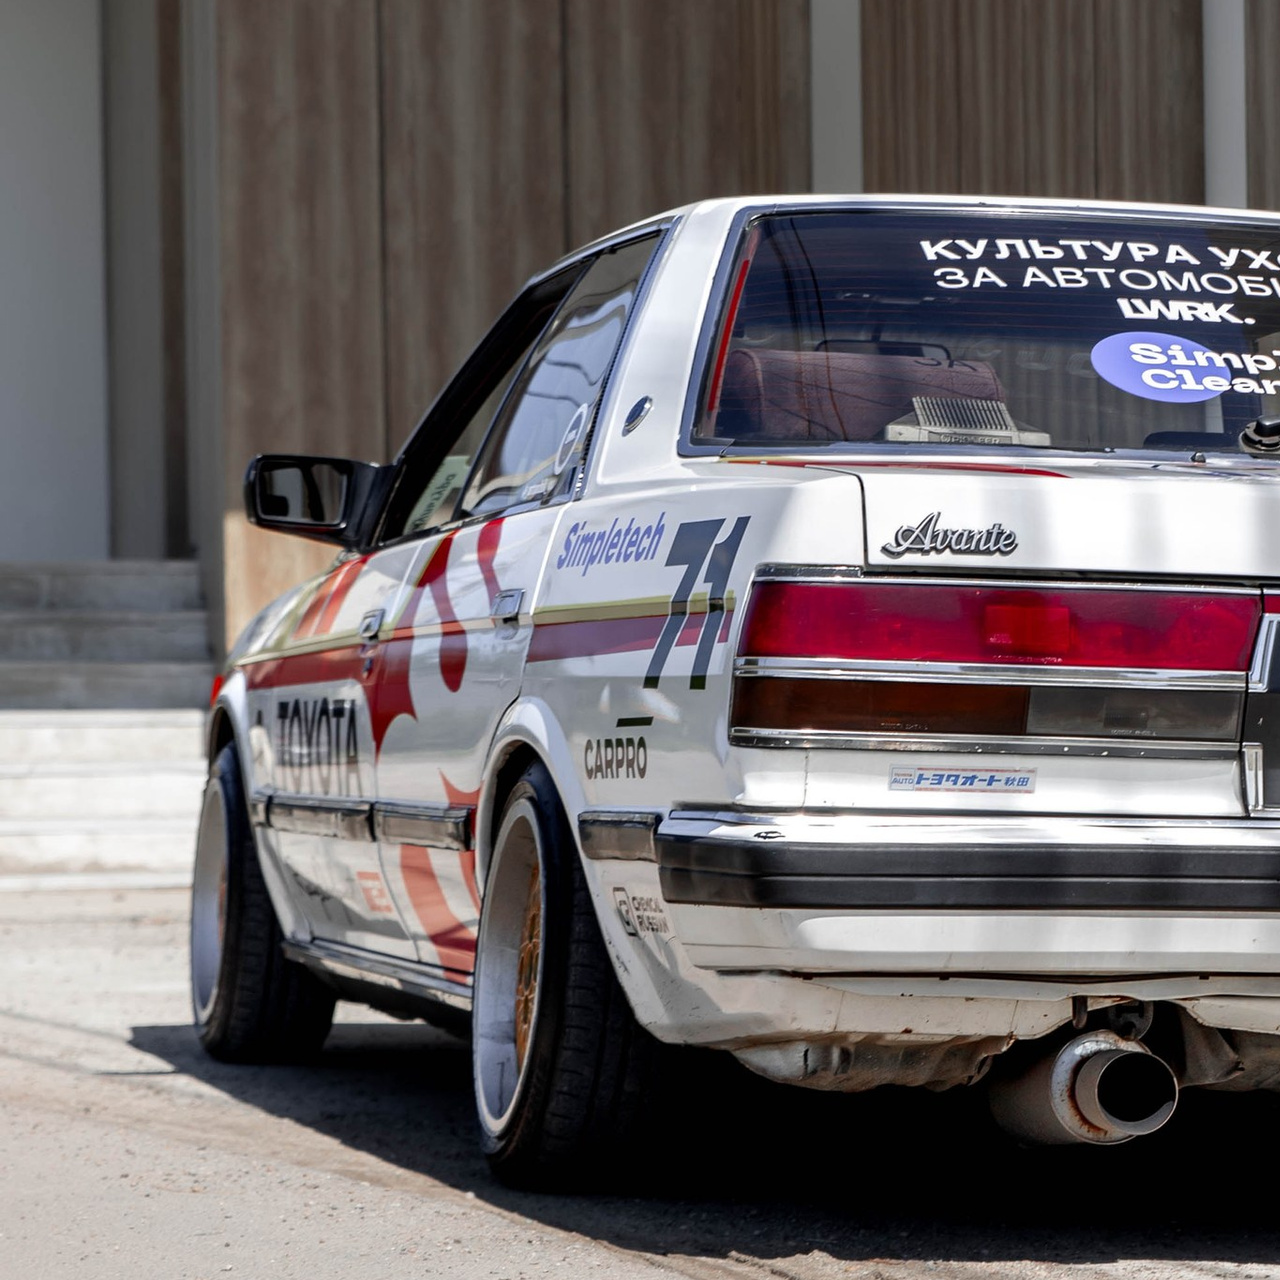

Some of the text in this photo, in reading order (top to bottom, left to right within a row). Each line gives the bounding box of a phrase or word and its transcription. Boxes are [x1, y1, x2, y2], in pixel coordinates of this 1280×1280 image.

[920, 238, 1201, 265] КУЛЬТУРА
[933, 266, 1007, 289] ЗА
[557, 512, 666, 577] Simpletech
[880, 511, 1018, 557] Avante
[642, 516, 752, 690] 71
[277, 696, 363, 798] TOYOTA
[584, 736, 647, 780] CARPRO
